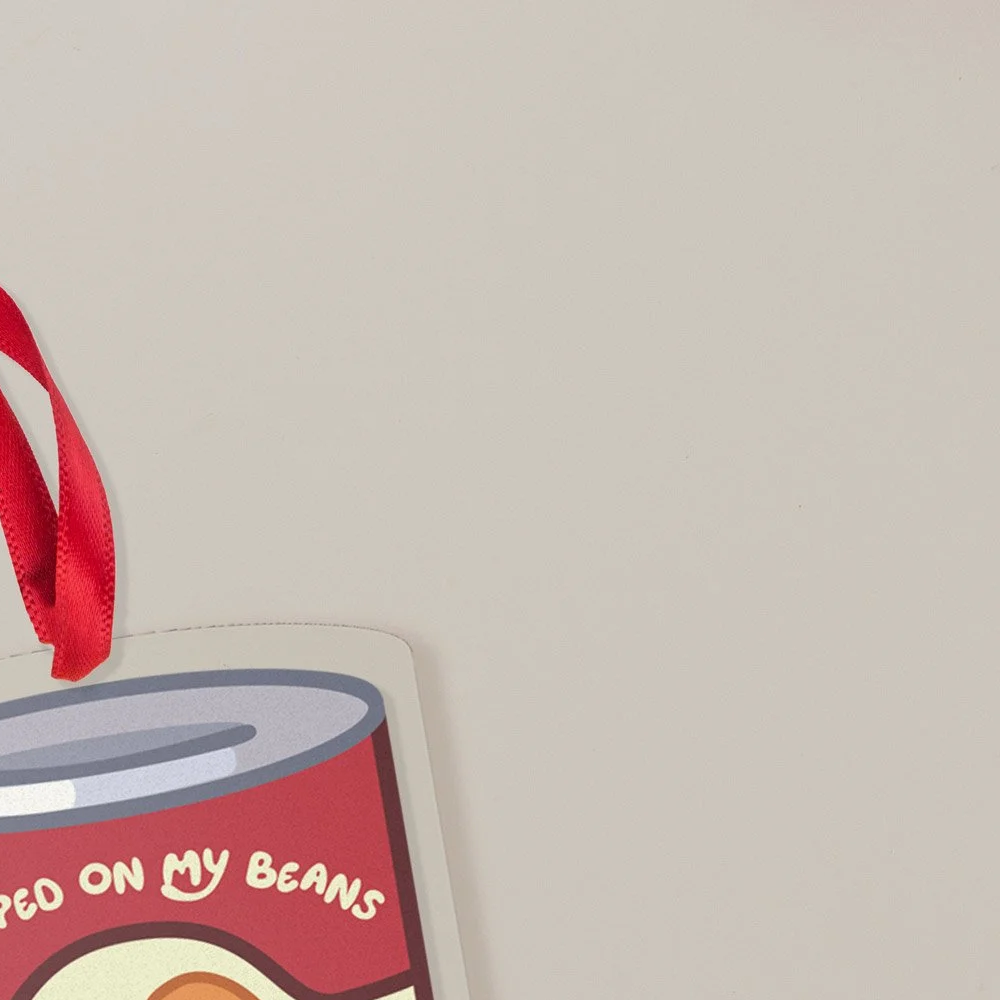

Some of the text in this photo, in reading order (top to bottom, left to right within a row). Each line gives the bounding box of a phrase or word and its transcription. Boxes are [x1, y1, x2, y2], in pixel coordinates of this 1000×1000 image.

[78, 856, 145, 896] ON
[160, 847, 230, 902] MY
[245, 850, 386, 920] BEANS
